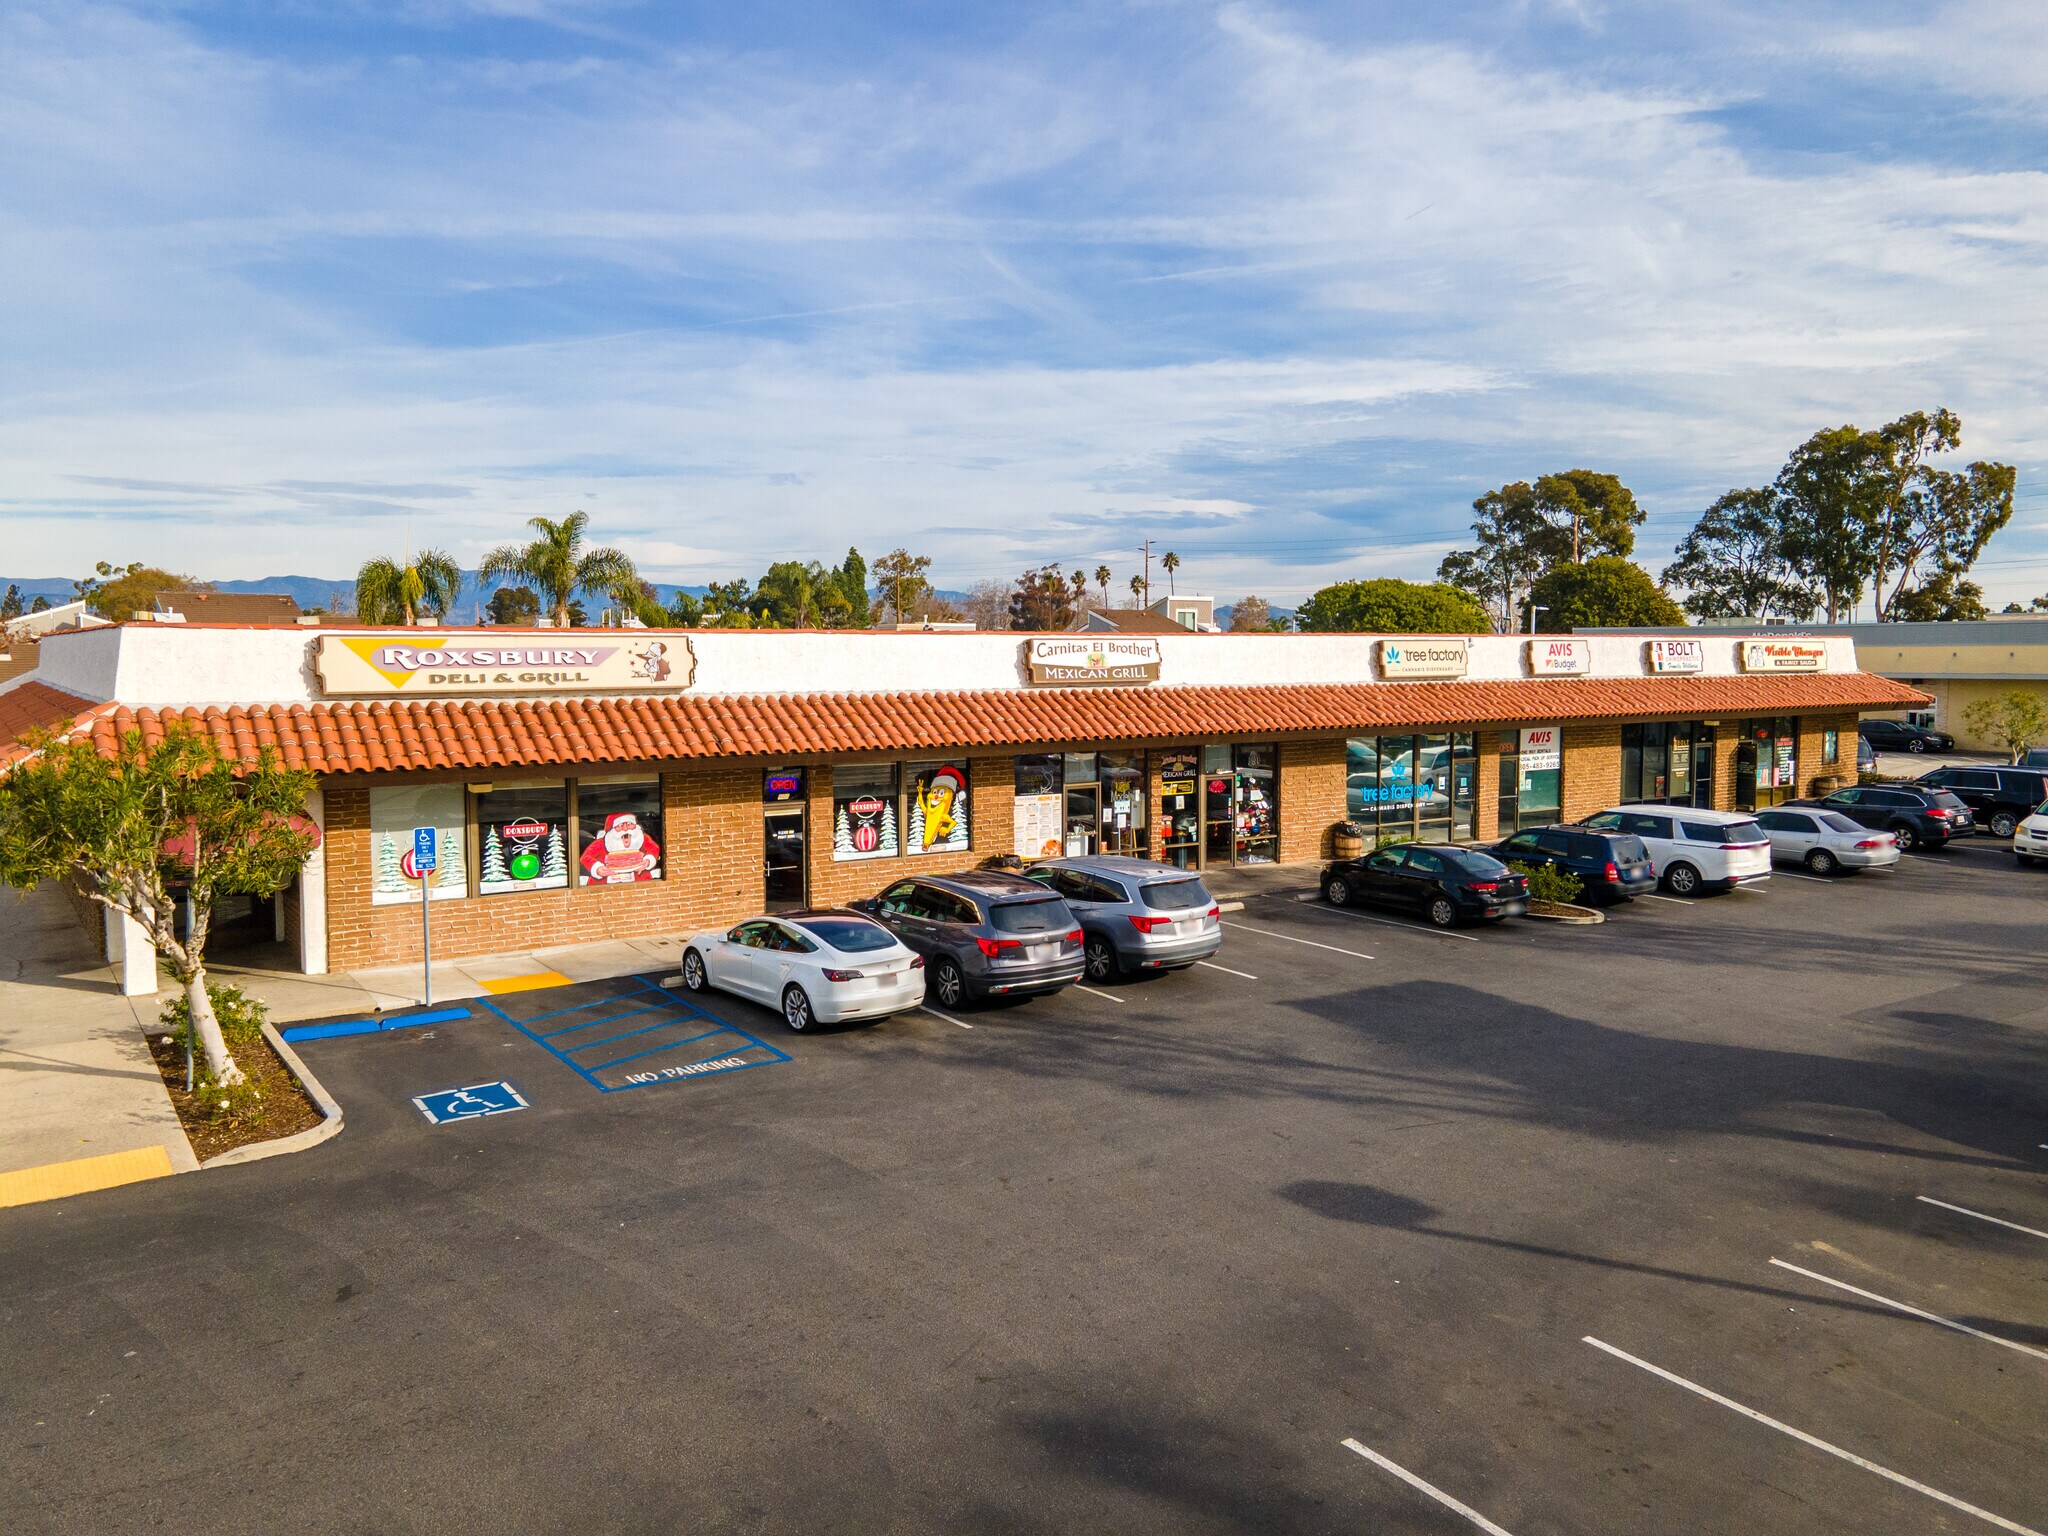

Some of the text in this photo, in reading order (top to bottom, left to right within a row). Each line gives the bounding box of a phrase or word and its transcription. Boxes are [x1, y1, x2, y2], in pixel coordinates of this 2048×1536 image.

[1037, 642, 1152, 658] Carnitas El Brother
[1404, 648, 1464, 663] tree factory
[1549, 643, 1572, 657] AVIS
[1668, 643, 1694, 656] BOLT
[1765, 645, 1824, 658] Visible Changes
[383, 648, 600, 670] ROXSBURY
[1554, 659, 1577, 669] Budget
[428, 672, 590, 686] DELI & GRILL
[1045, 666, 1148, 679] MEXICAN GRILL
[1528, 731, 1551, 744] AVIS
[771, 780, 796, 790] OPEN
[1370, 802, 1426, 812] CANABIS DISPENARY
[505, 826, 546, 836] ROXSBURY
[625, 1057, 748, 1084] NO PARKING
